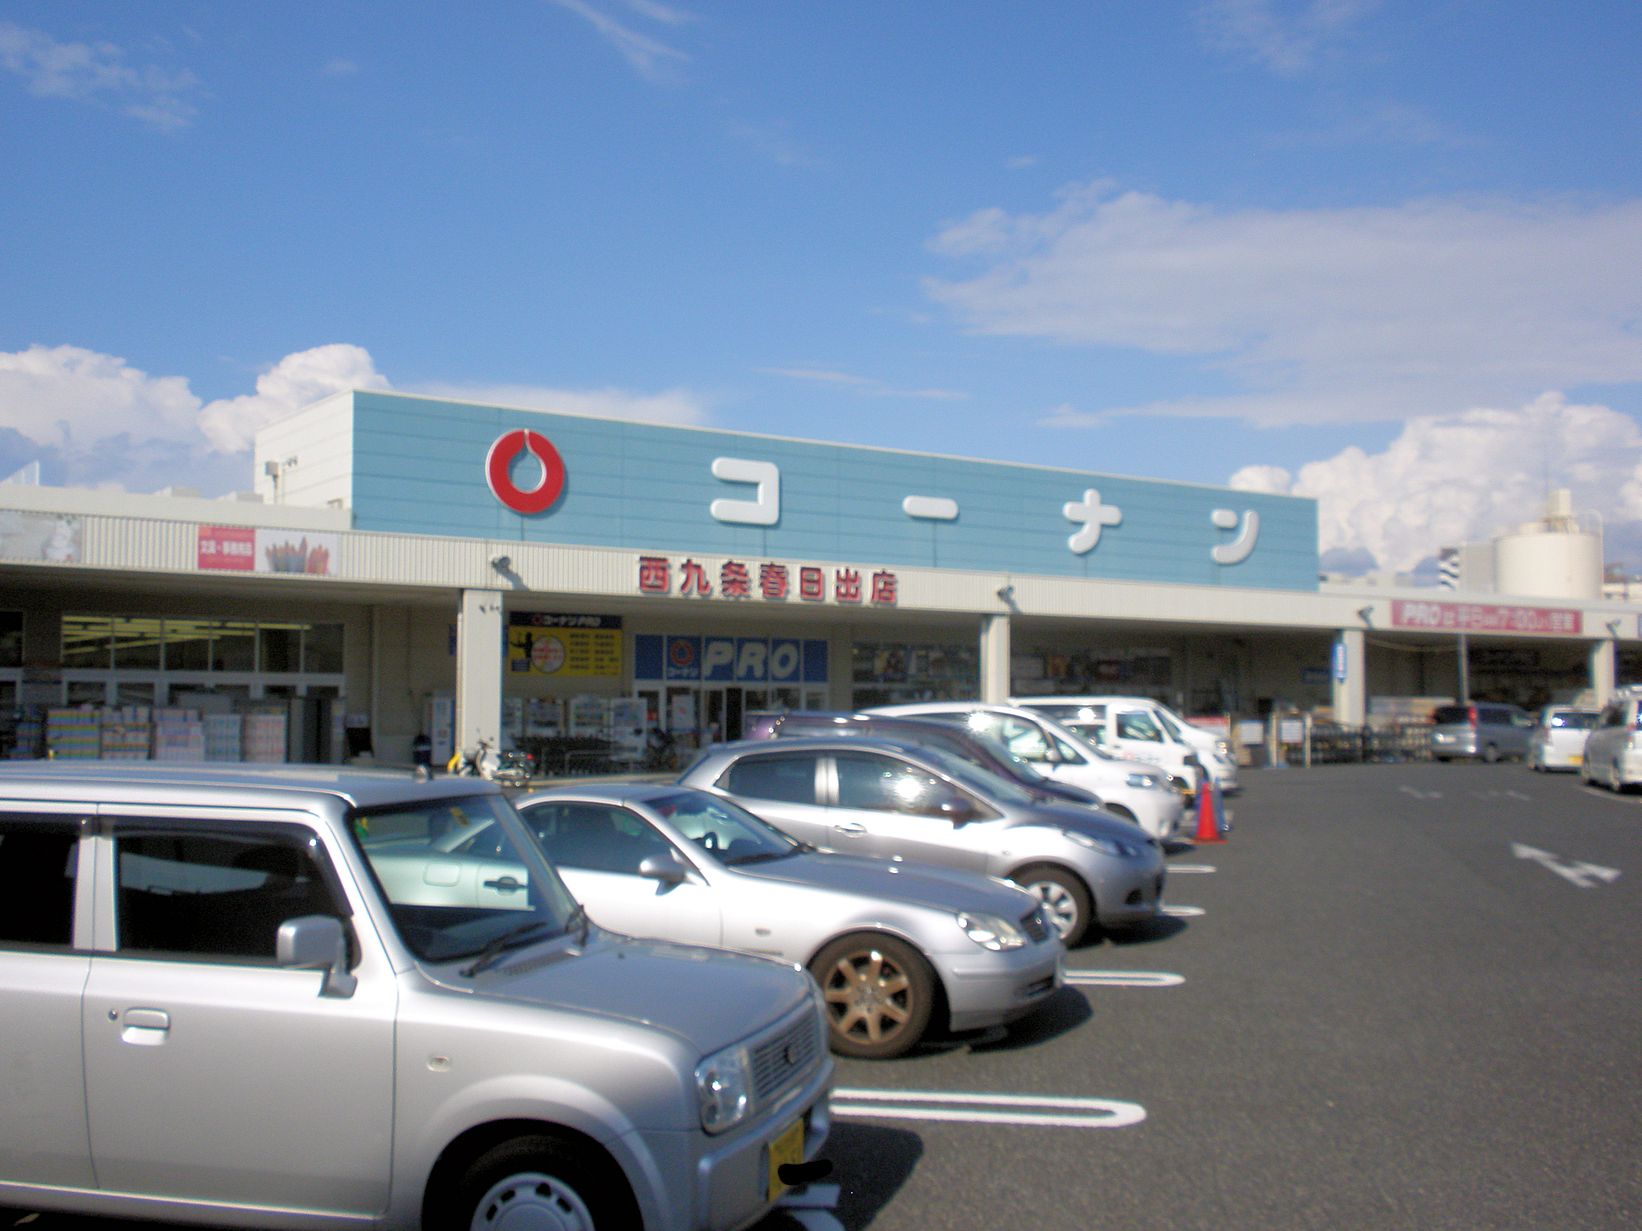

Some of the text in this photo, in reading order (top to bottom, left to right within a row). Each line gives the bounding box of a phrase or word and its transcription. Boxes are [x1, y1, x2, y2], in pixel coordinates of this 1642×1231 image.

[709, 456, 1261, 566] コーナン
[639, 555, 898, 606] 西九条春日出店
[703, 640, 799, 680] PRO
